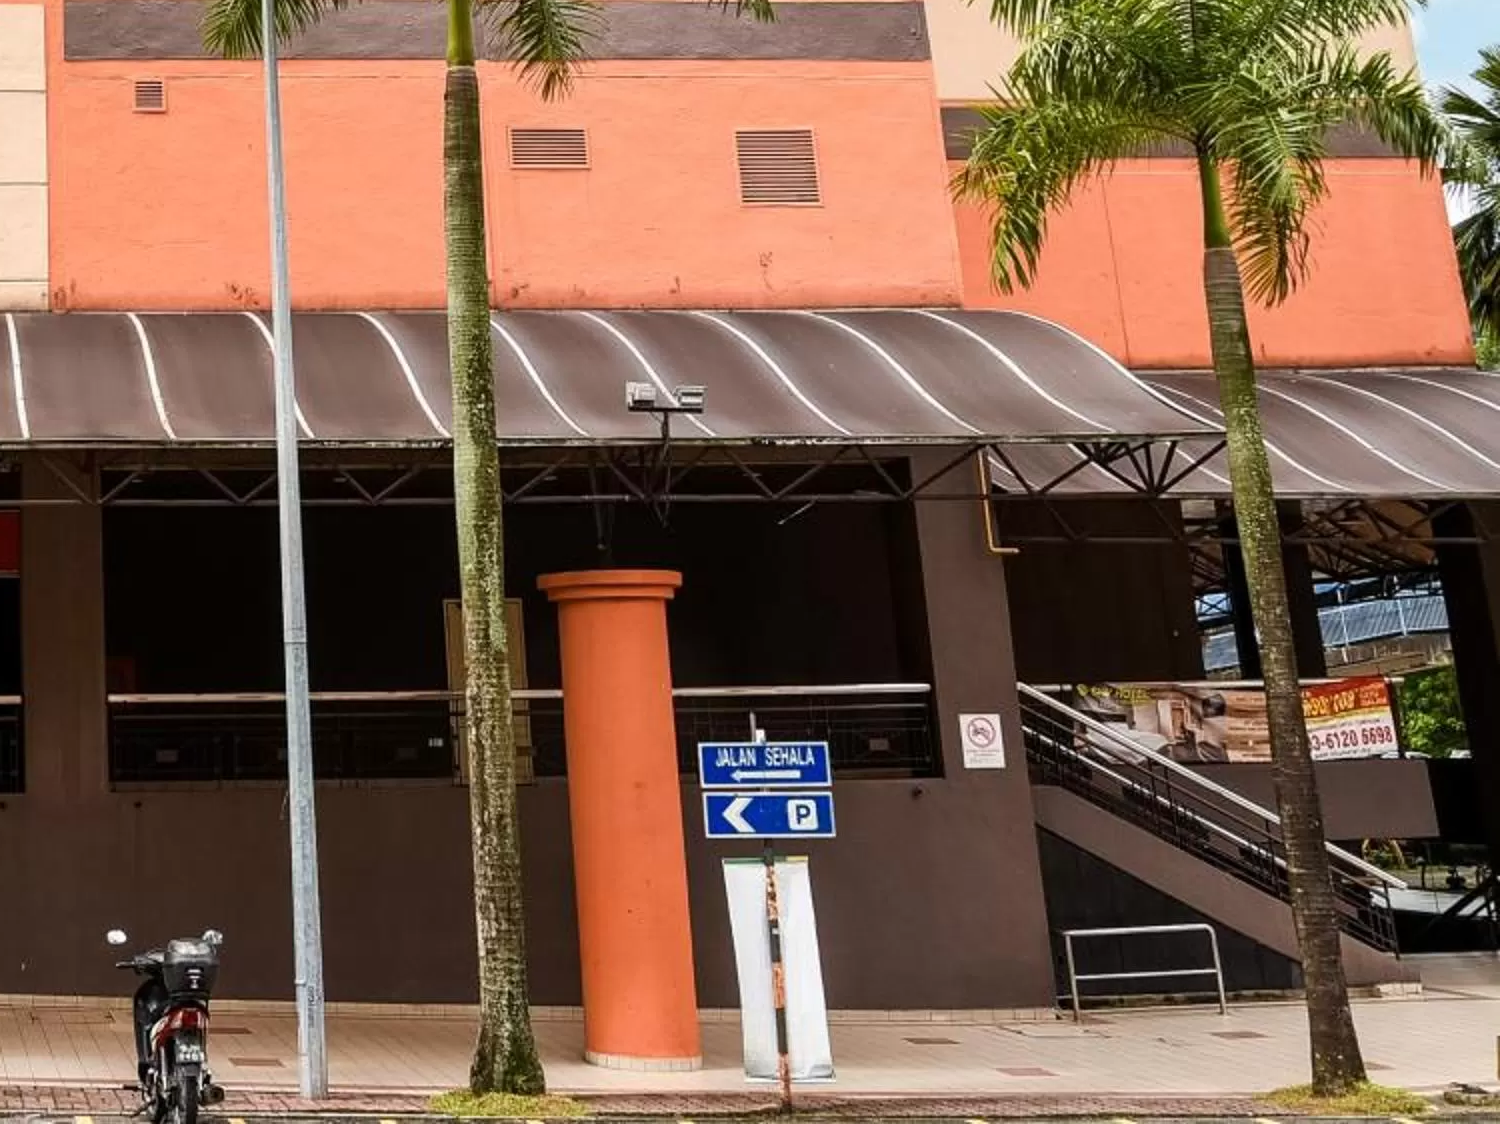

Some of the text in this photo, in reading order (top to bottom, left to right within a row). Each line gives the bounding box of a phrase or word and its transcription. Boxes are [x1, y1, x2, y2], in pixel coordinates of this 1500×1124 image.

[1309, 730, 1358, 751] 3-6120
[716, 747, 815, 767] JALAN SEHALA
[796, 804, 810, 825] P
